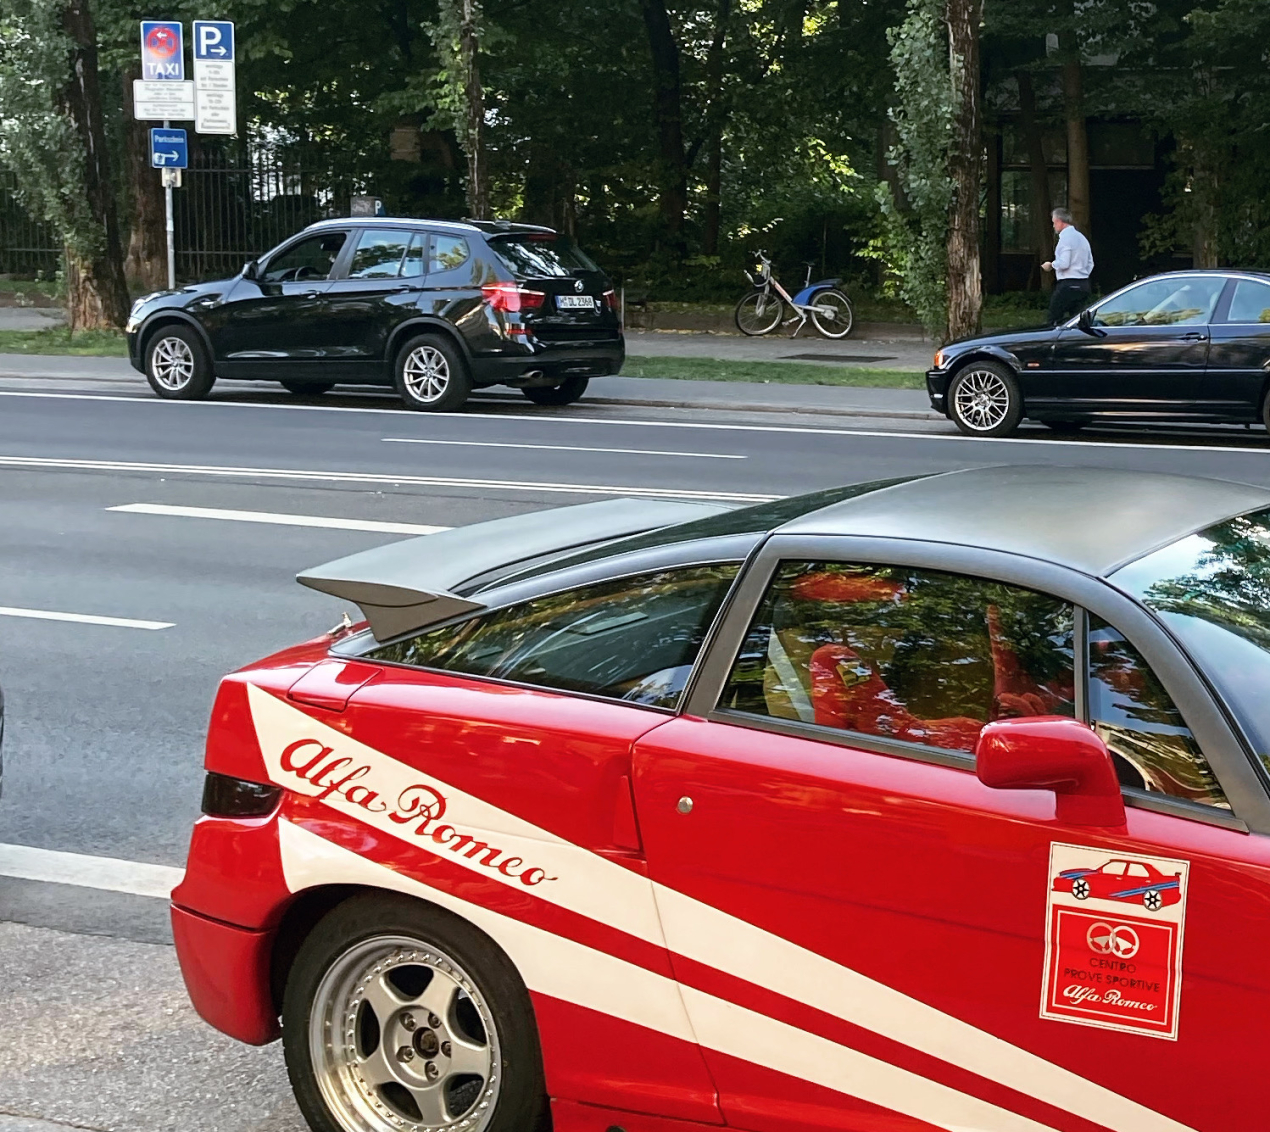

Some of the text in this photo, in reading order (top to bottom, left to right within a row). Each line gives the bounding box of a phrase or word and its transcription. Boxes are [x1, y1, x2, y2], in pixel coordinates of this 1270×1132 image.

[200, 26, 222, 56] P
[147, 62, 179, 76] TAXI
[374, 200, 382, 215] P
[280, 738, 558, 886] Alfa Romeo
[1089, 957, 1137, 973] CENTRO
[1063, 967, 1160, 993] PROVE SPORTIVE
[1063, 984, 1158, 1011] Alfa Romeo
